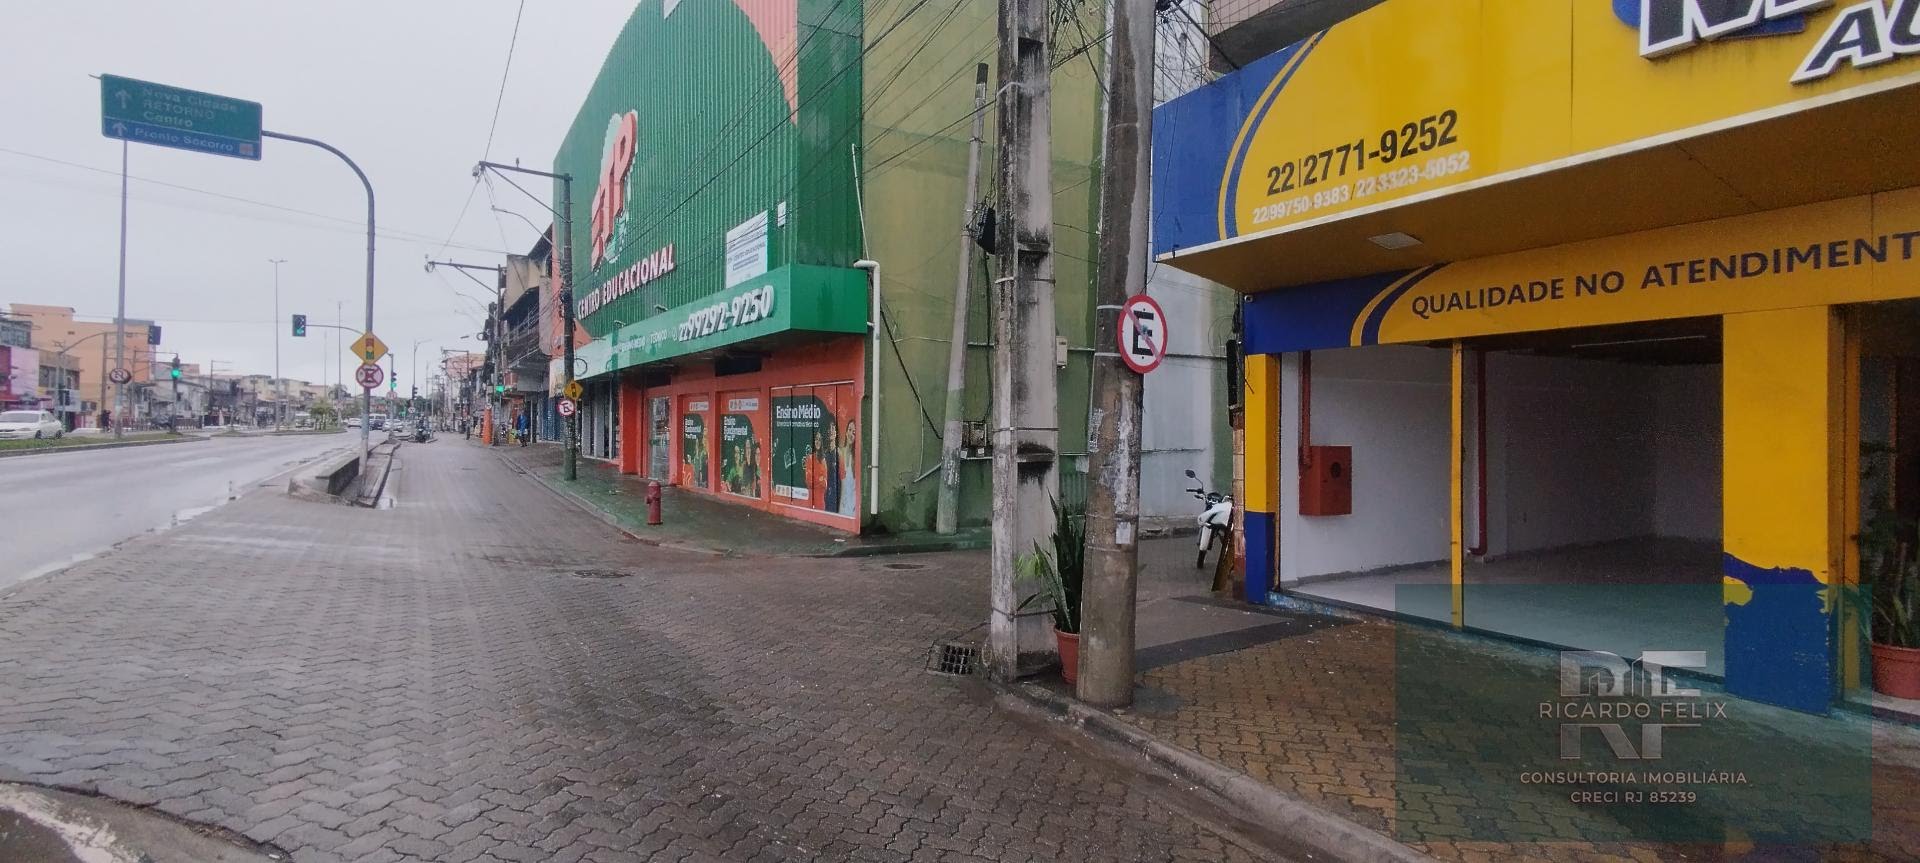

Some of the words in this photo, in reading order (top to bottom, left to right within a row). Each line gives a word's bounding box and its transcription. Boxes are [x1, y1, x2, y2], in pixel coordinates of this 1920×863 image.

[143, 87, 180, 102] Nova
[188, 96, 238, 113] Cidade
[144, 99, 214, 120] RETORNO
[144, 111, 193, 127] Centro
[135, 128, 178, 142] Pronto
[184, 136, 234, 151] Socorro
[578, 288, 600, 320] CENTRO
[603, 243, 674, 306] EDUCACIONAL
[1412, 278, 1564, 320] QUALIDADE
[1575, 271, 1624, 297] NO
[1132, 310, 1154, 356] E
[776, 404, 798, 419] Ensino
[798, 403, 821, 419] Médio
